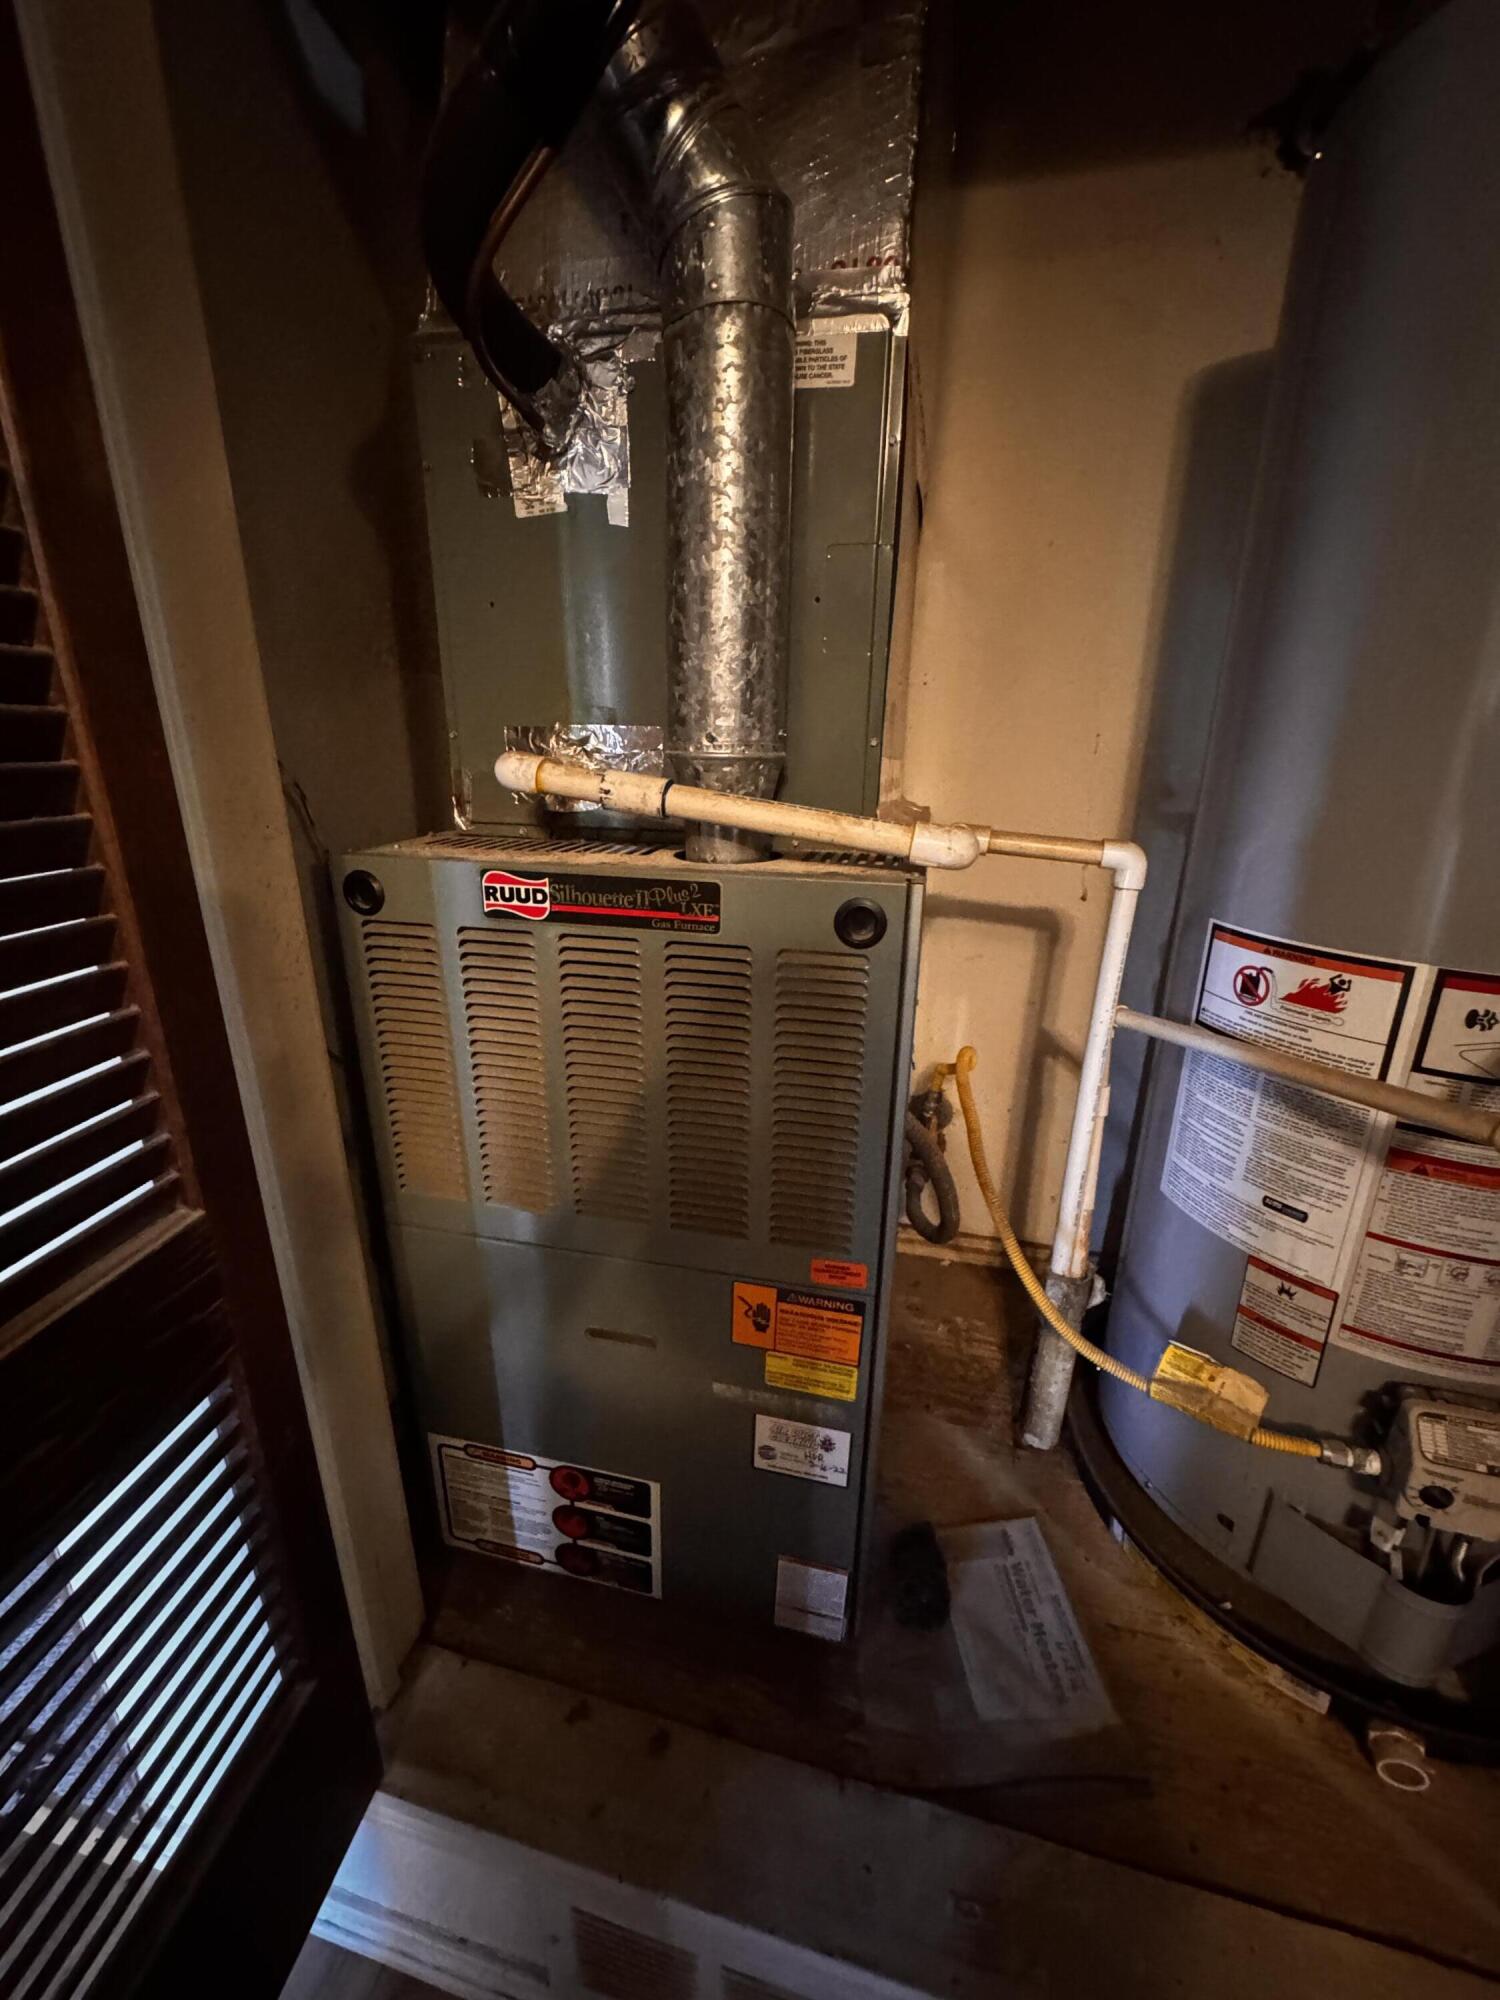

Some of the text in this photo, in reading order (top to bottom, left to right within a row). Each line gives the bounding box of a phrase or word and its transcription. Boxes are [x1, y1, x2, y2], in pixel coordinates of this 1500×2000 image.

[484, 885, 549, 905] RUUD
[550, 883, 634, 909] Silhouette
[651, 919, 716, 932] Gas Furnace
[798, 1295, 854, 1312] WARNING
